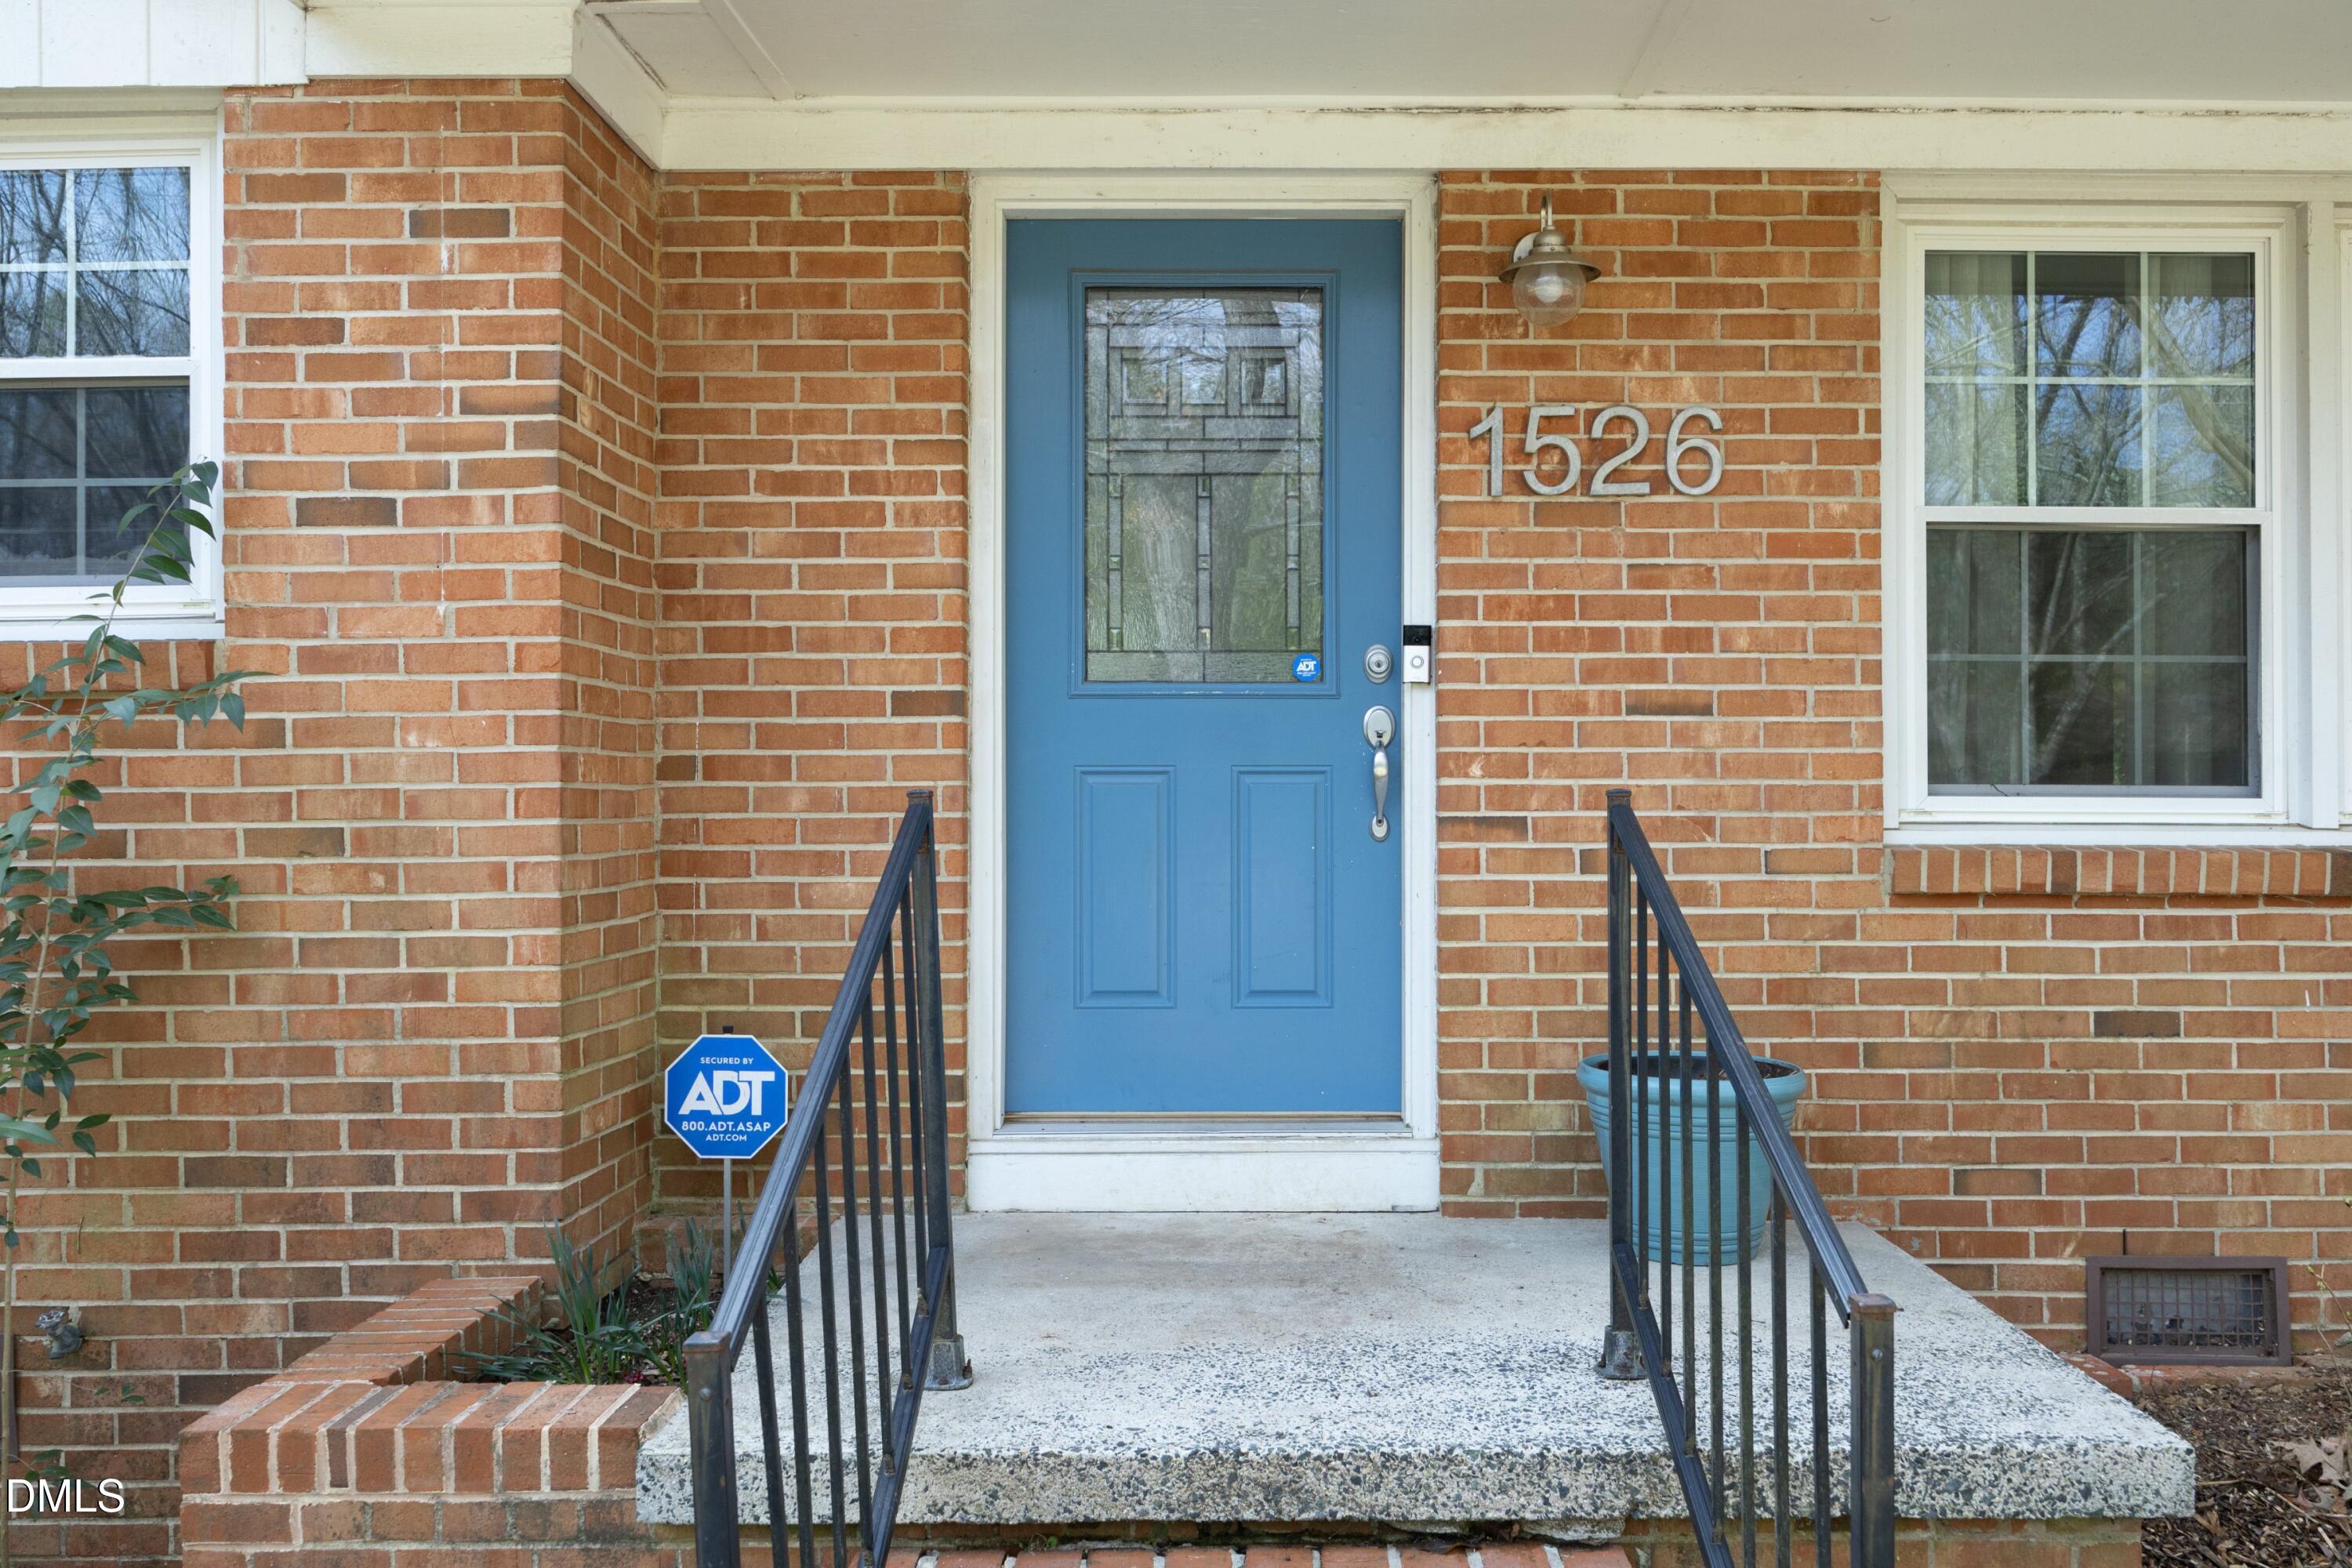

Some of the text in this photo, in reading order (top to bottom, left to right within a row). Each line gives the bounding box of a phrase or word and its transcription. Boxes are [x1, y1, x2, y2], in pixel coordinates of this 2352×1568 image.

[1468, 405, 1723, 496] 1526
[1297, 661, 1316, 671] ADT
[677, 1070, 775, 1116] ADT
[681, 1121, 771, 1132] 800.ADT.ASAP
